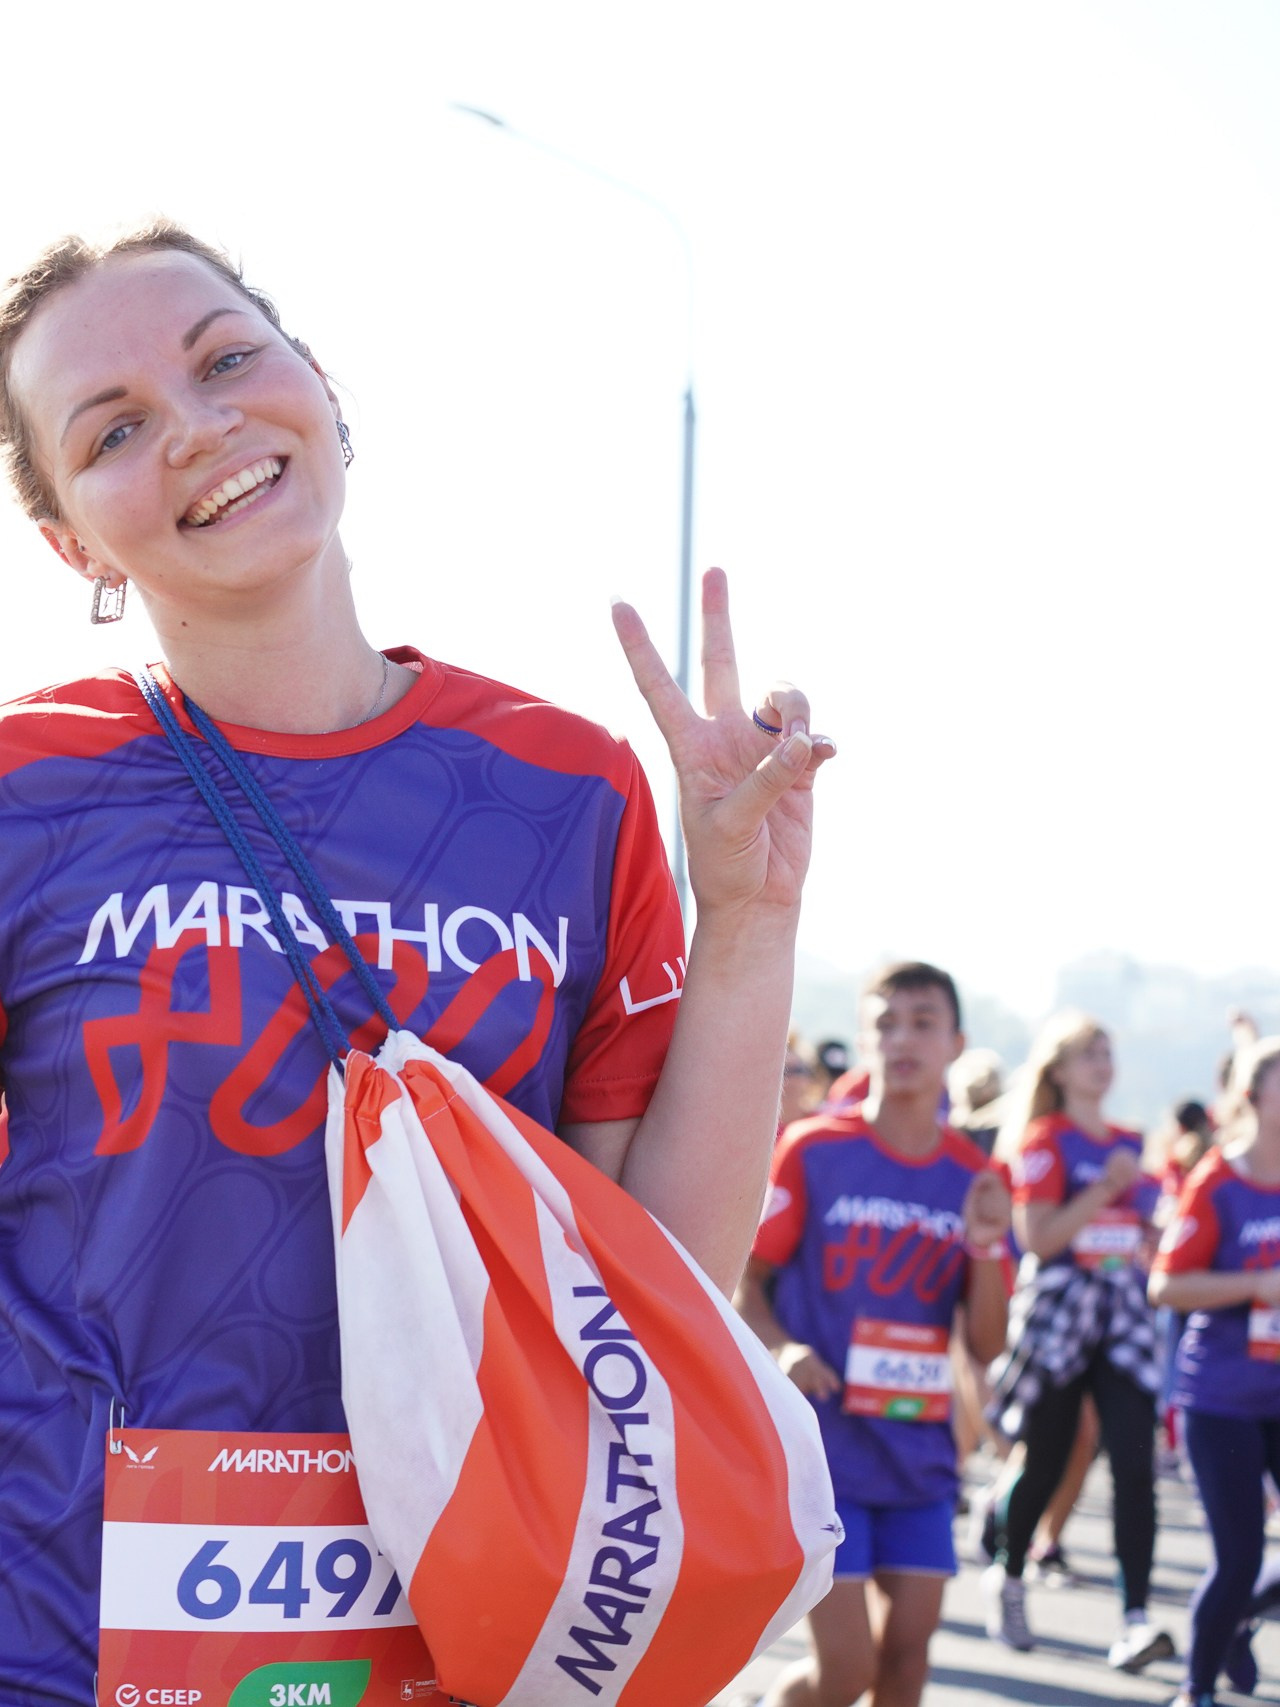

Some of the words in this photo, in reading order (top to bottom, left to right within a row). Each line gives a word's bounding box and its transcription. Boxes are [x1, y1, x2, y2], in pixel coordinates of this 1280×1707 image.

[75, 880, 569, 988] MARATHON
[555, 1286, 662, 1697] MARATHON
[145, 1688, 202, 1706] СБЕР
